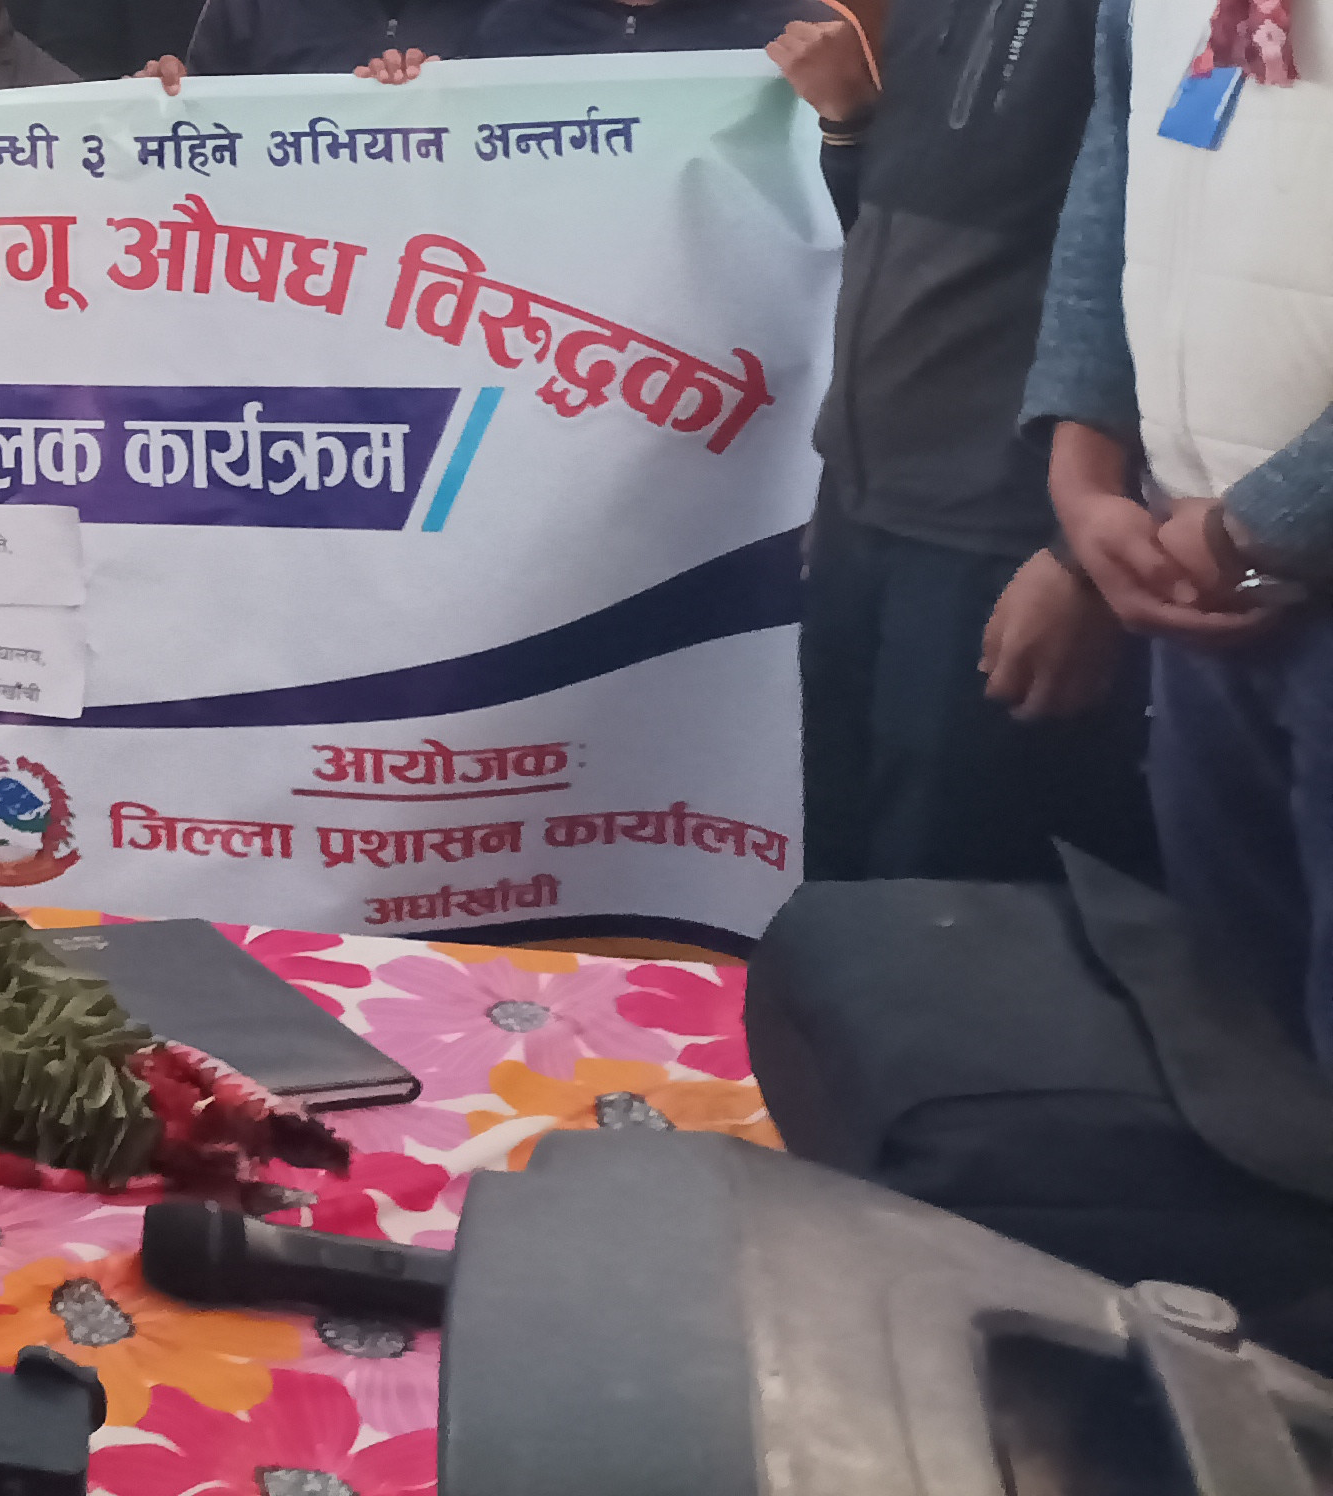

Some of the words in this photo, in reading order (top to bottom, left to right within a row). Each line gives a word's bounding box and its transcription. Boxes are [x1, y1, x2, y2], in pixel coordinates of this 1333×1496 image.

[81, 137, 107, 179] ३
[133, 121, 242, 177] महिने
[268, 116, 450, 167] अभियान
[475, 105, 642, 162] अन्तर्गत
[106, 193, 368, 315] औषध
[124, 401, 410, 496] कार्यक्रम
[108, 801, 296, 860] जिल्ला
[316, 820, 526, 869] प्रशासन
[544, 800, 790, 872] कार्यालय
